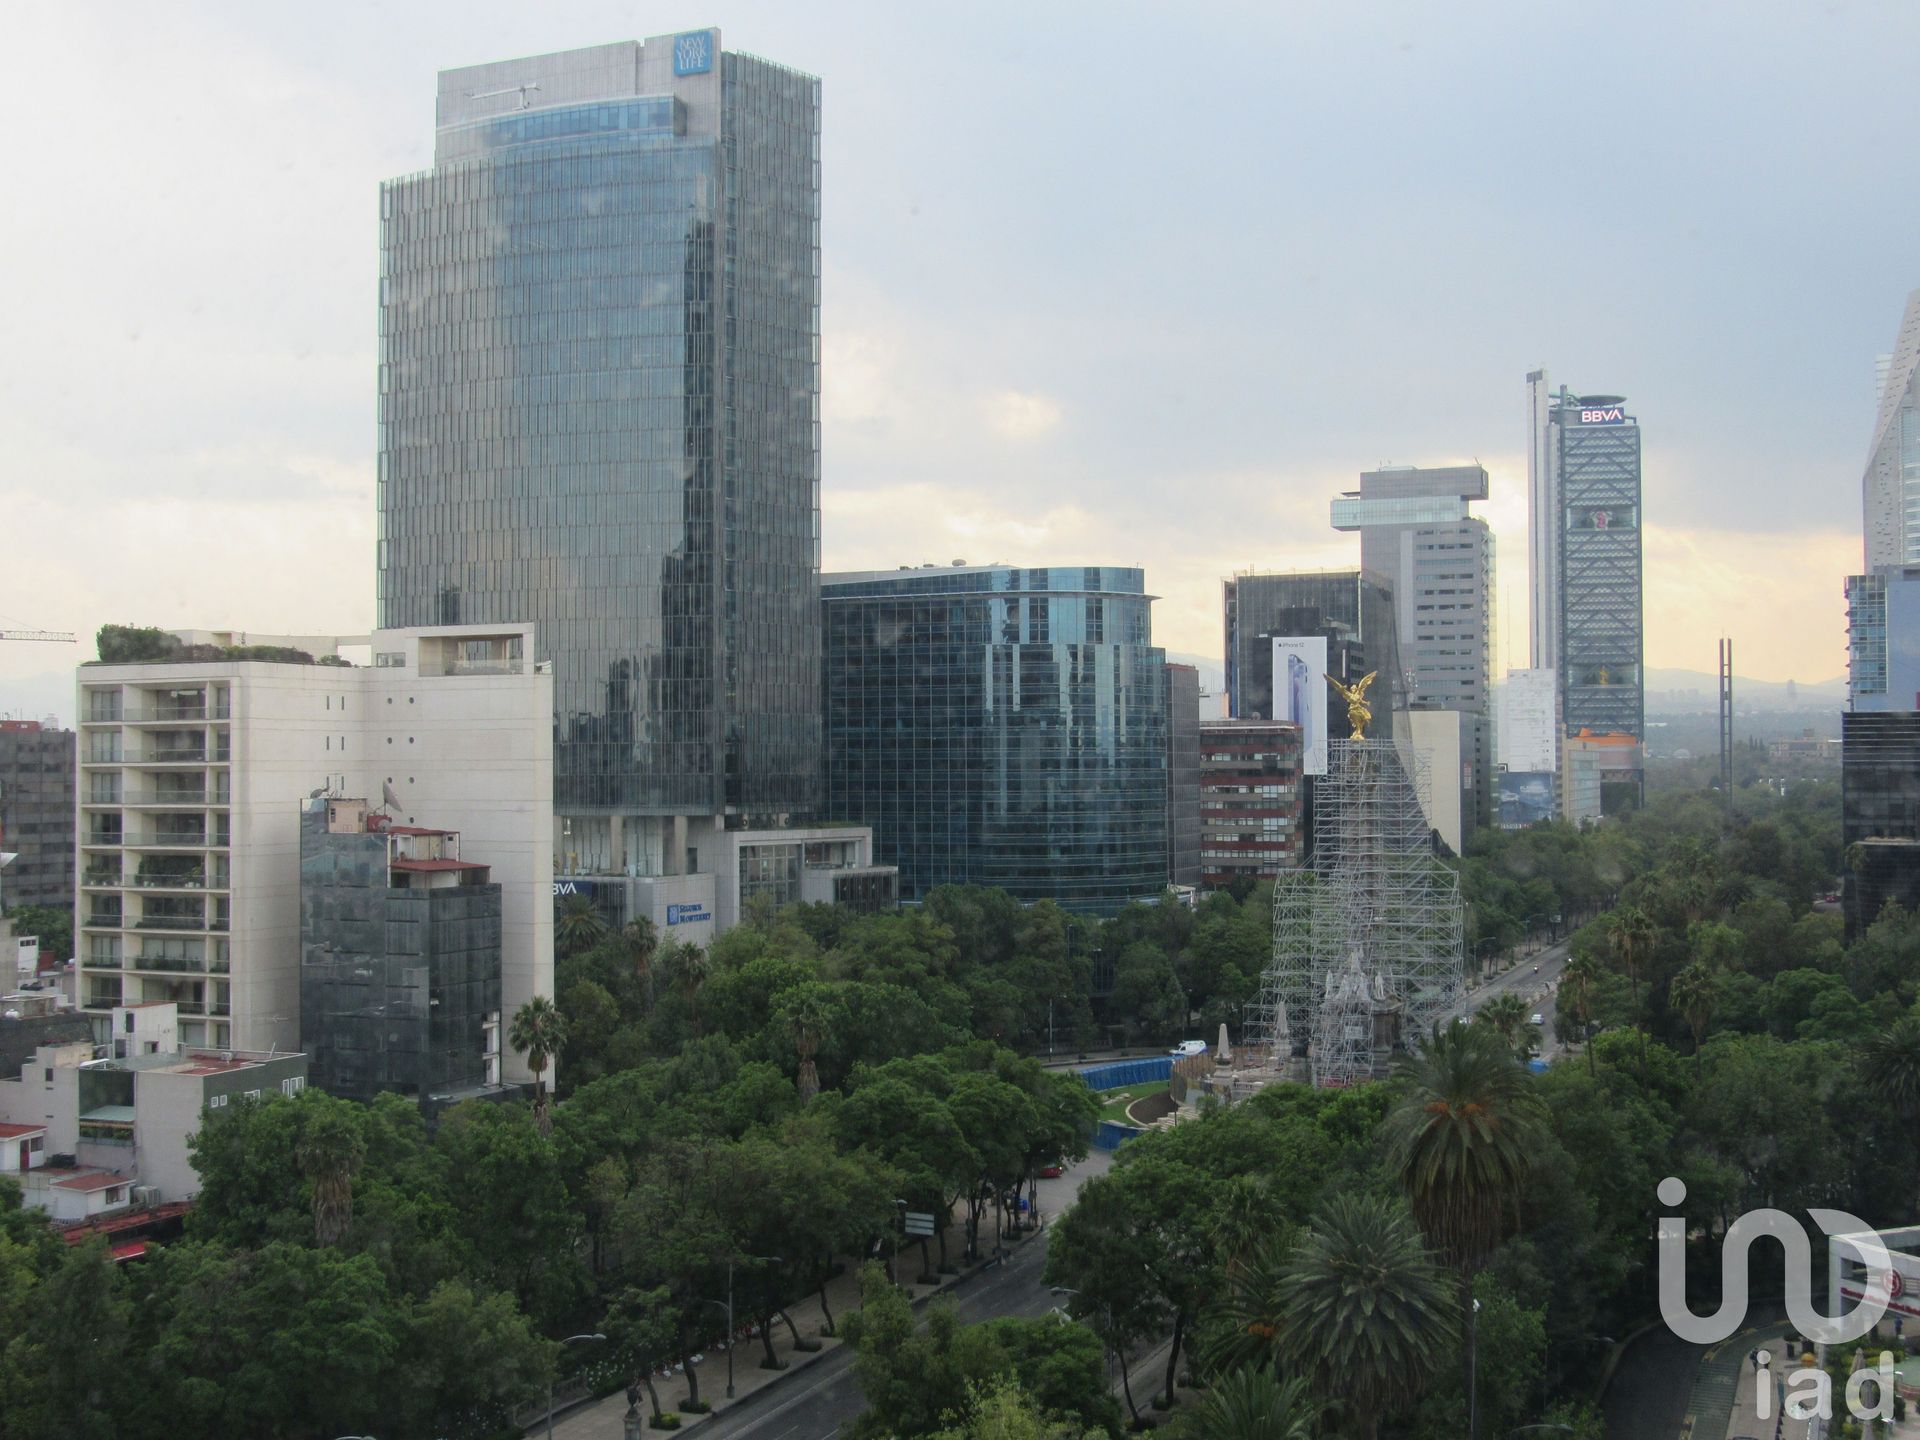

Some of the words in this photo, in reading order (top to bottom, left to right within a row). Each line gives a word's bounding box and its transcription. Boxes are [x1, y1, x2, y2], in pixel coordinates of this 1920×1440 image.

[680, 36, 705, 49] NEW
[676, 46, 706, 60] YORK
[680, 56, 704, 70] LIFE
[1581, 409, 1622, 422] BBVA
